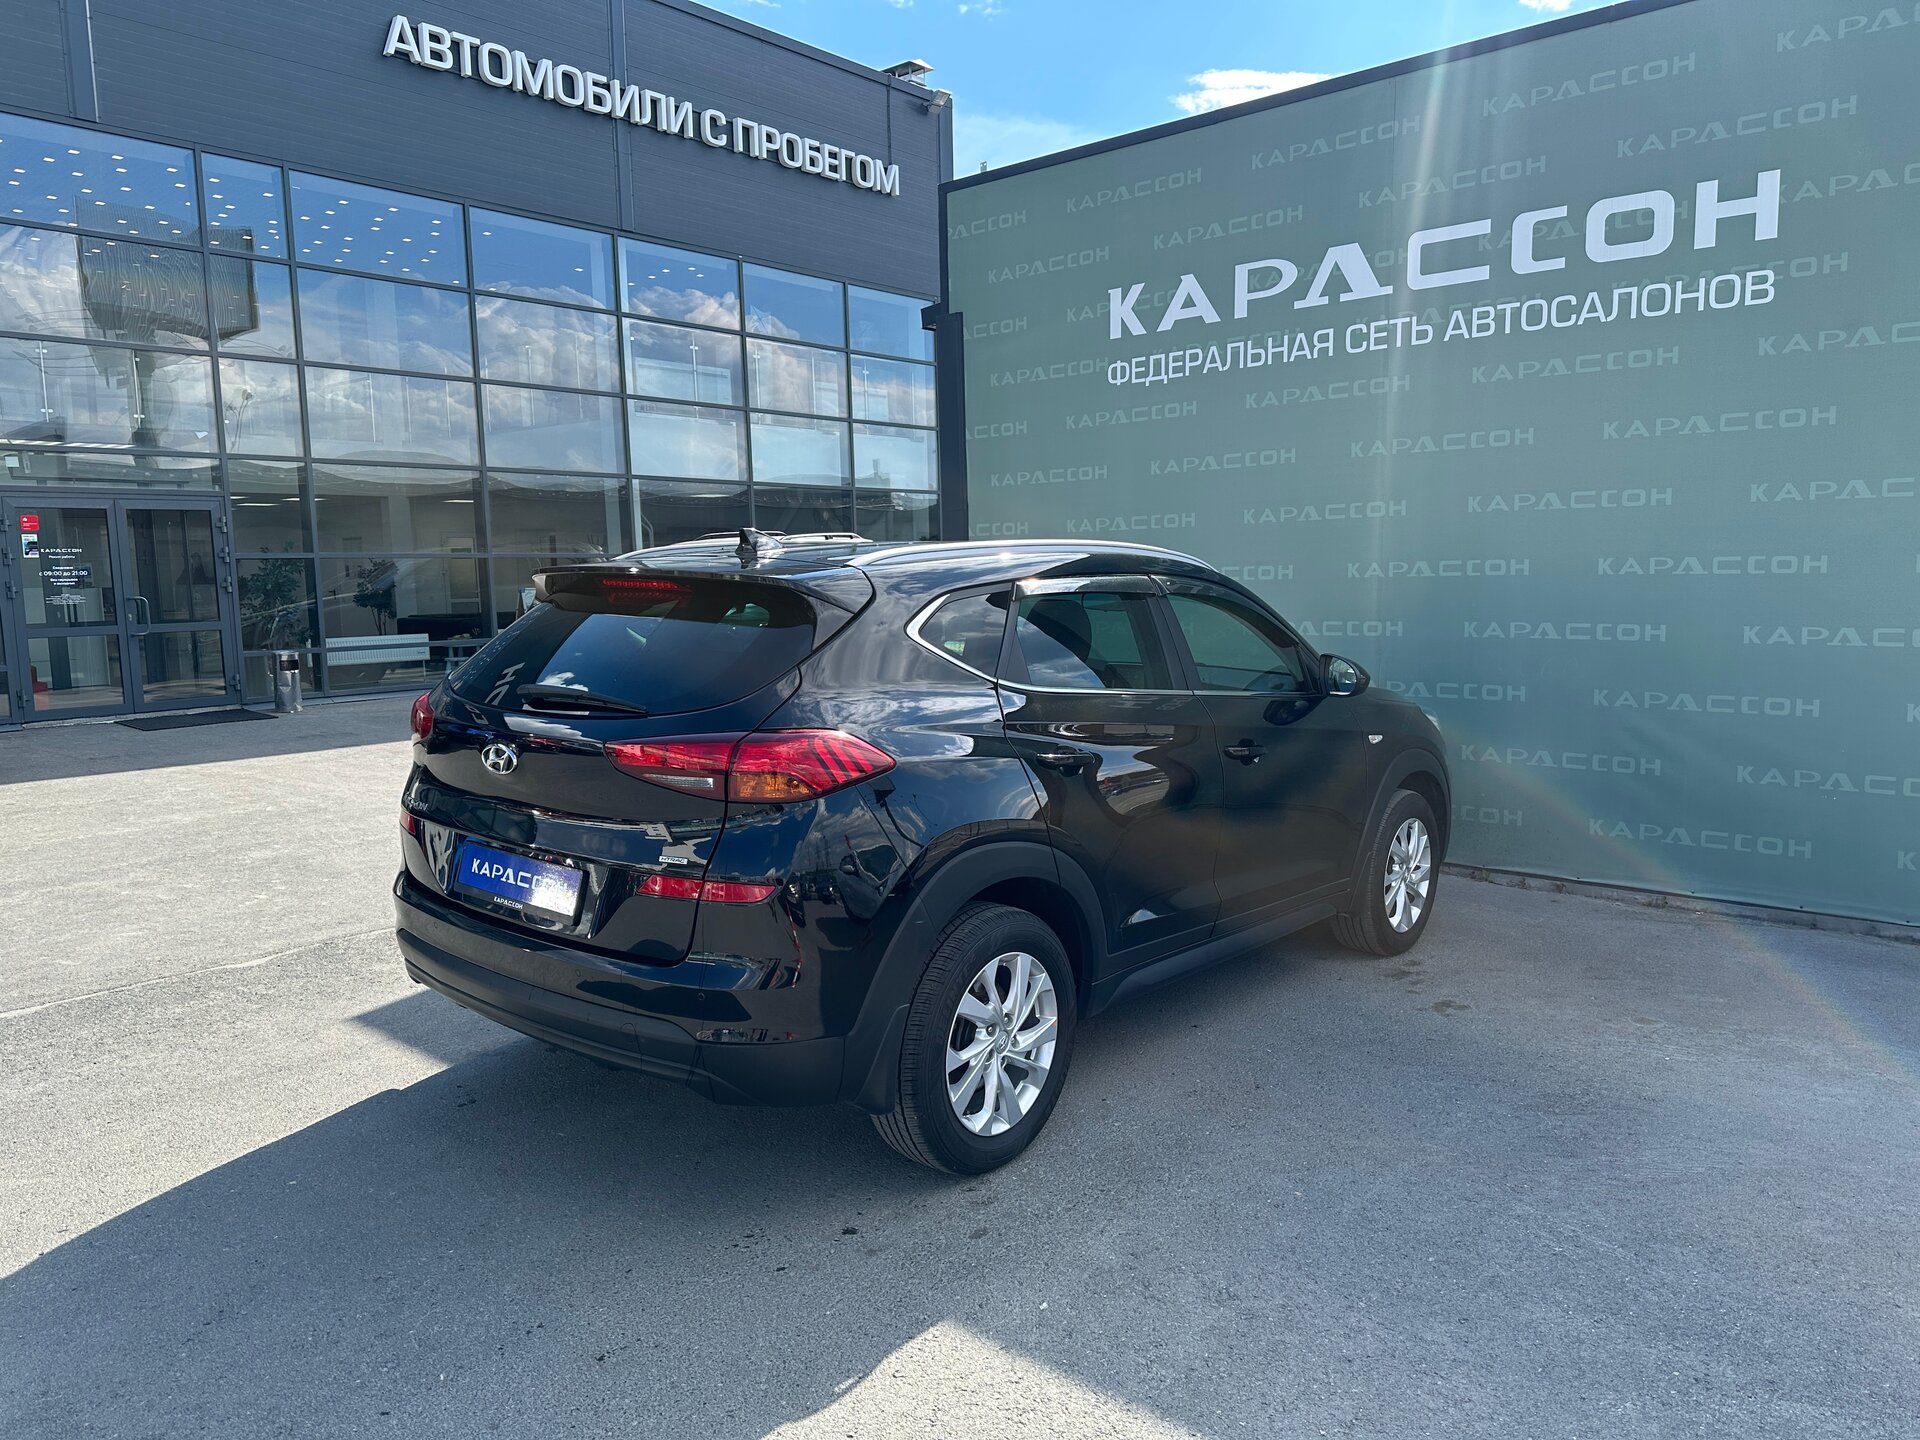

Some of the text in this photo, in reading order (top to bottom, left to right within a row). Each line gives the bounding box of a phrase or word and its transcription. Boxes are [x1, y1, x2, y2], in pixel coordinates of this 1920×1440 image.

[1777, 5, 1920, 52] КАРА
[1483, 52, 1696, 117] КАРАССОН
[383, 15, 900, 196] АВТОМОБИЛИ С ПРОБЕГОМ
[1251, 116, 1420, 170] КАРАССОН
[1617, 95, 1857, 158] КАРАССОН
[1067, 168, 1201, 213] КАРАССОН
[1359, 155, 1546, 208] КАРАССОН
[1153, 205, 1303, 250] КАРАССОН
[988, 246, 1109, 285] КАРАССОН
[1108, 169, 1780, 340] КАРАССОН
[1107, 269, 1775, 386] ФЕДЕРАЛЬНАЯ СЕТЬ АВТОСАЛОНОВ
[1758, 321, 1920, 356] КАРАС
[990, 357, 1108, 388] КАРАССОН
[1472, 346, 1679, 383] КАРАССОН
[1246, 375, 1411, 409] КАРАССОН
[1066, 401, 1197, 430] КАРАССОН
[1603, 405, 1837, 440] КАРАССОН
[1351, 427, 1534, 458] КАРАССОН
[991, 465, 1108, 488] КАРАССОН
[1151, 447, 1296, 476] КАРАССОН
[1467, 488, 1673, 513] КАРАССОН
[1750, 477, 1915, 502] КАРАС
[1067, 513, 1196, 533] КАРАССОН
[1244, 500, 1407, 525] КАРАССОН
[1348, 559, 1530, 579] КАРАССОН
[1598, 555, 1828, 576] КАРАССОН
[1292, 621, 1403, 637] АССОН
[1464, 621, 1667, 642] КАРАССОН
[1370, 680, 1527, 702] РАССОН
[1594, 689, 1820, 718] КАРАССОН
[1461, 744, 1661, 776] КАРАССОН
[1589, 818, 1812, 859] КАРАССОН
[471, 858, 568, 892] КАРАСС
[494, 896, 523, 909] КАРАССОН
